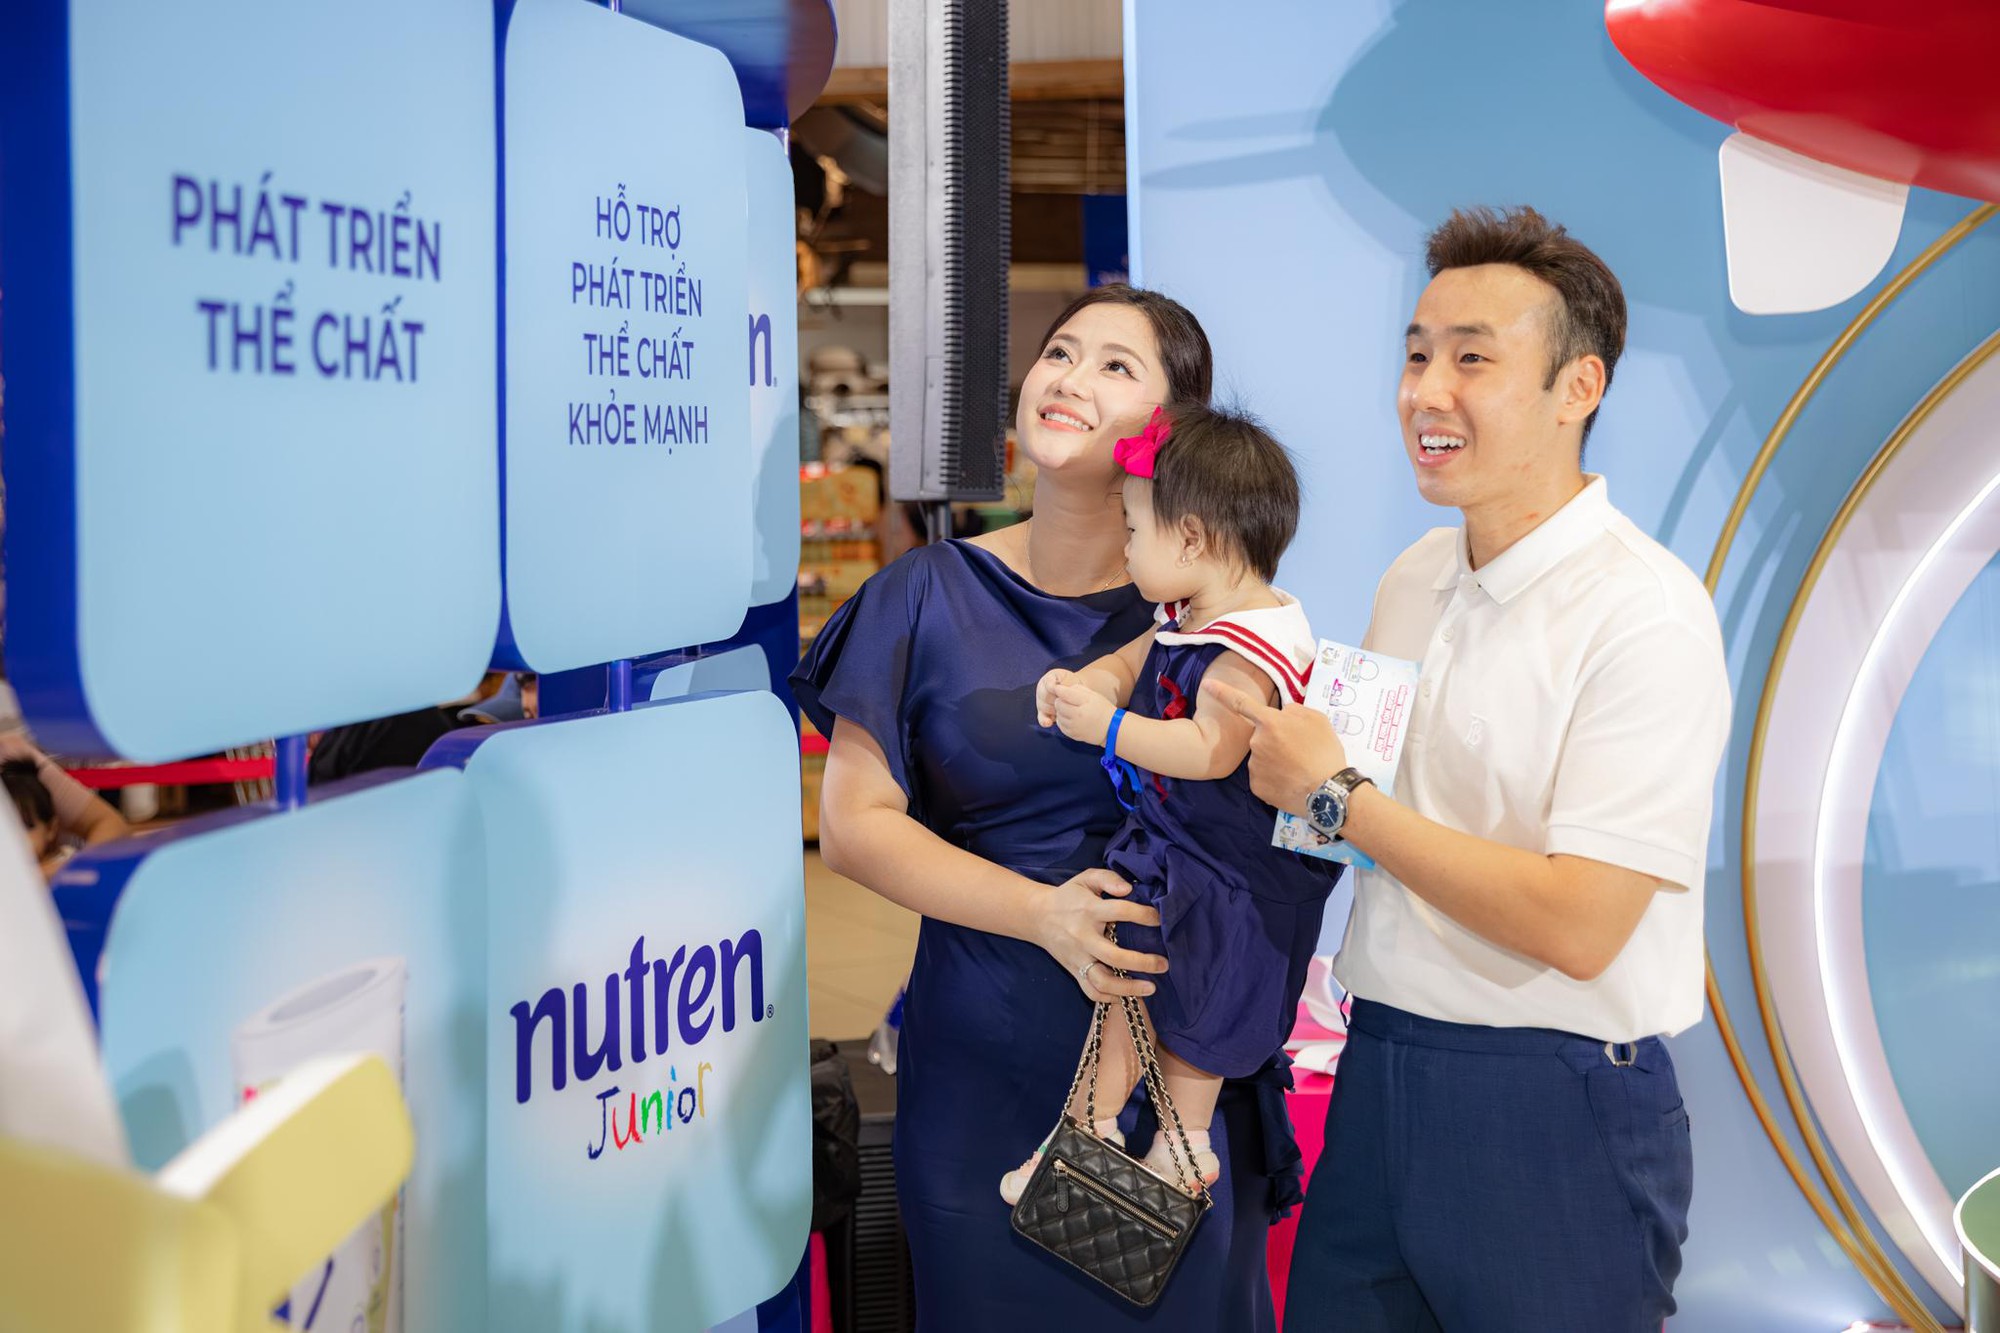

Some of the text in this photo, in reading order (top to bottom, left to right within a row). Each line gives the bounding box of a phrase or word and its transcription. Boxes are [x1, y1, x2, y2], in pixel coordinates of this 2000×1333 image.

[170, 170, 442, 283] PHÁT TRIỂN
[596, 182, 681, 261] HỖ TRỢ
[572, 256, 702, 318] PHÁT TRIỂN
[195, 281, 426, 384] THỂ CHẤT
[582, 319, 631, 378] THỂ
[636, 326, 695, 381] CHẤT
[568, 388, 708, 456] KHỎE MẠNH
[587, 1060, 713, 1161] Junior
